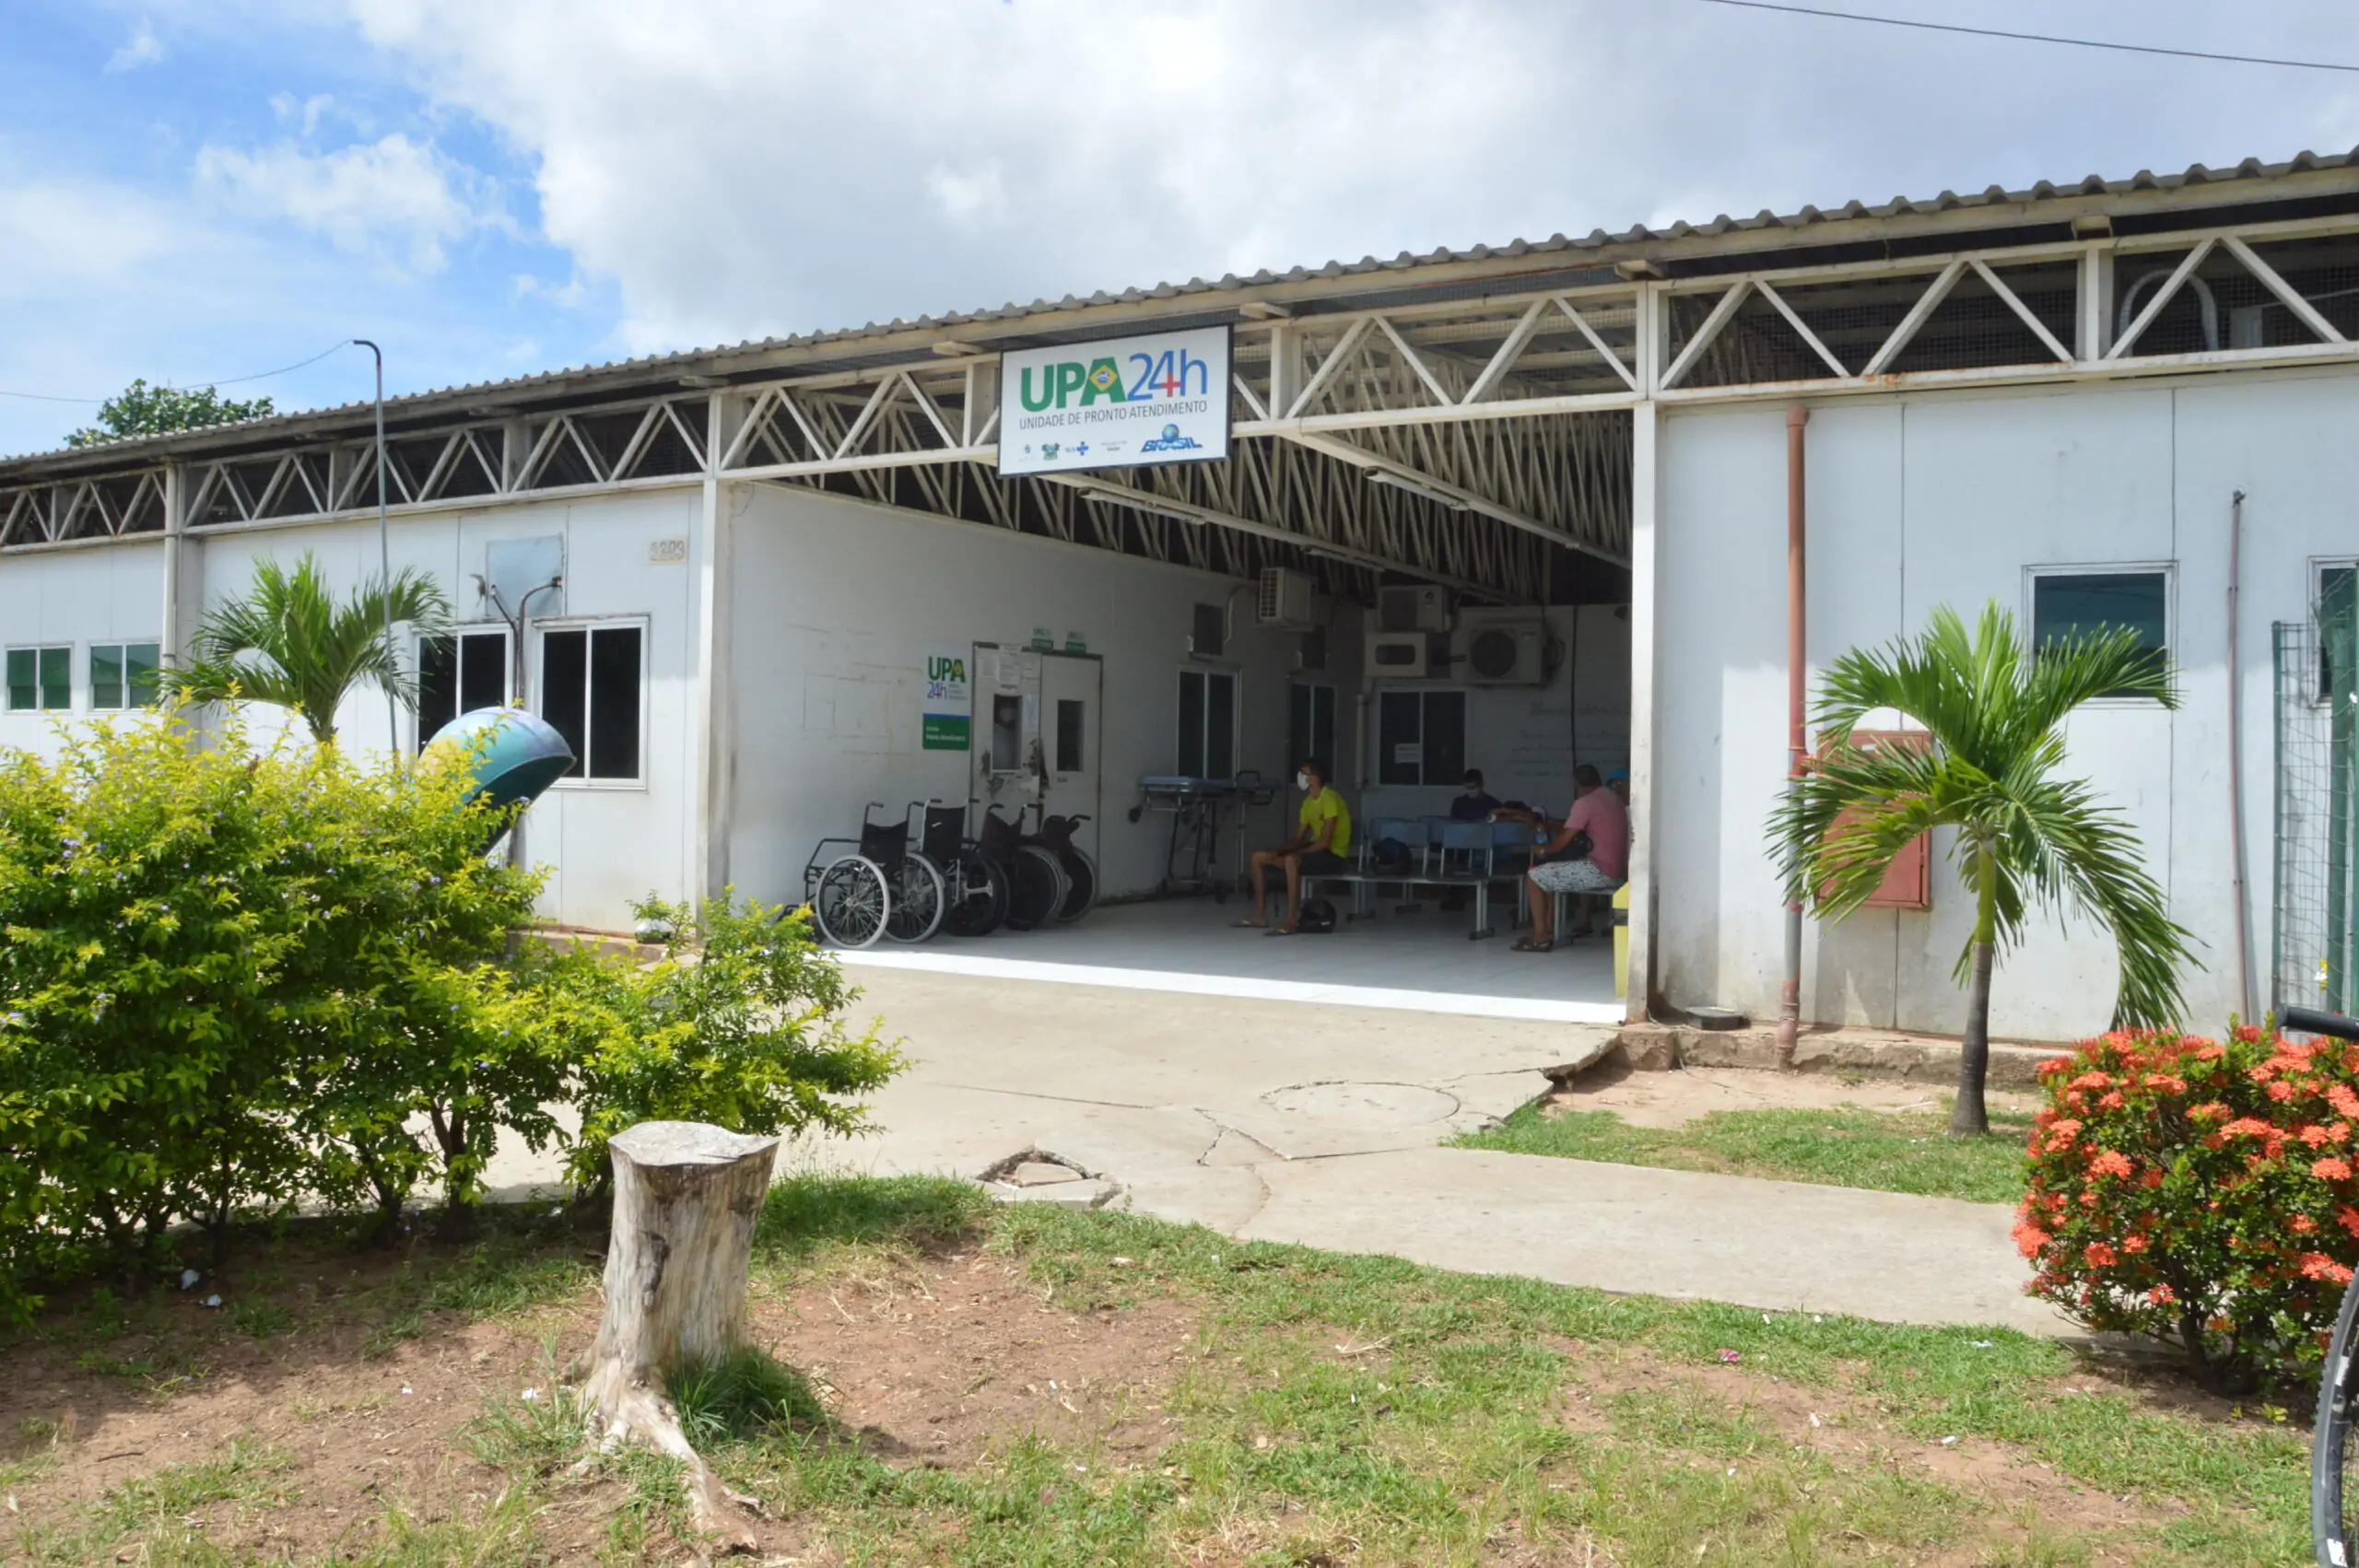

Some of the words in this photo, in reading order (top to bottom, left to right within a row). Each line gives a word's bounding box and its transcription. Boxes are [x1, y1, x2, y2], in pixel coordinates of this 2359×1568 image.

[1020, 357, 1127, 413] UPA
[1126, 348, 1208, 402] 24h
[1019, 414, 1065, 430] UNIDADE
[1067, 412, 1081, 425] DE
[1084, 407, 1127, 423] PRONTO
[1129, 400, 1208, 419] ATENDIMENTO
[928, 656, 966, 683] UPA
[927, 680, 947, 699] 24h
